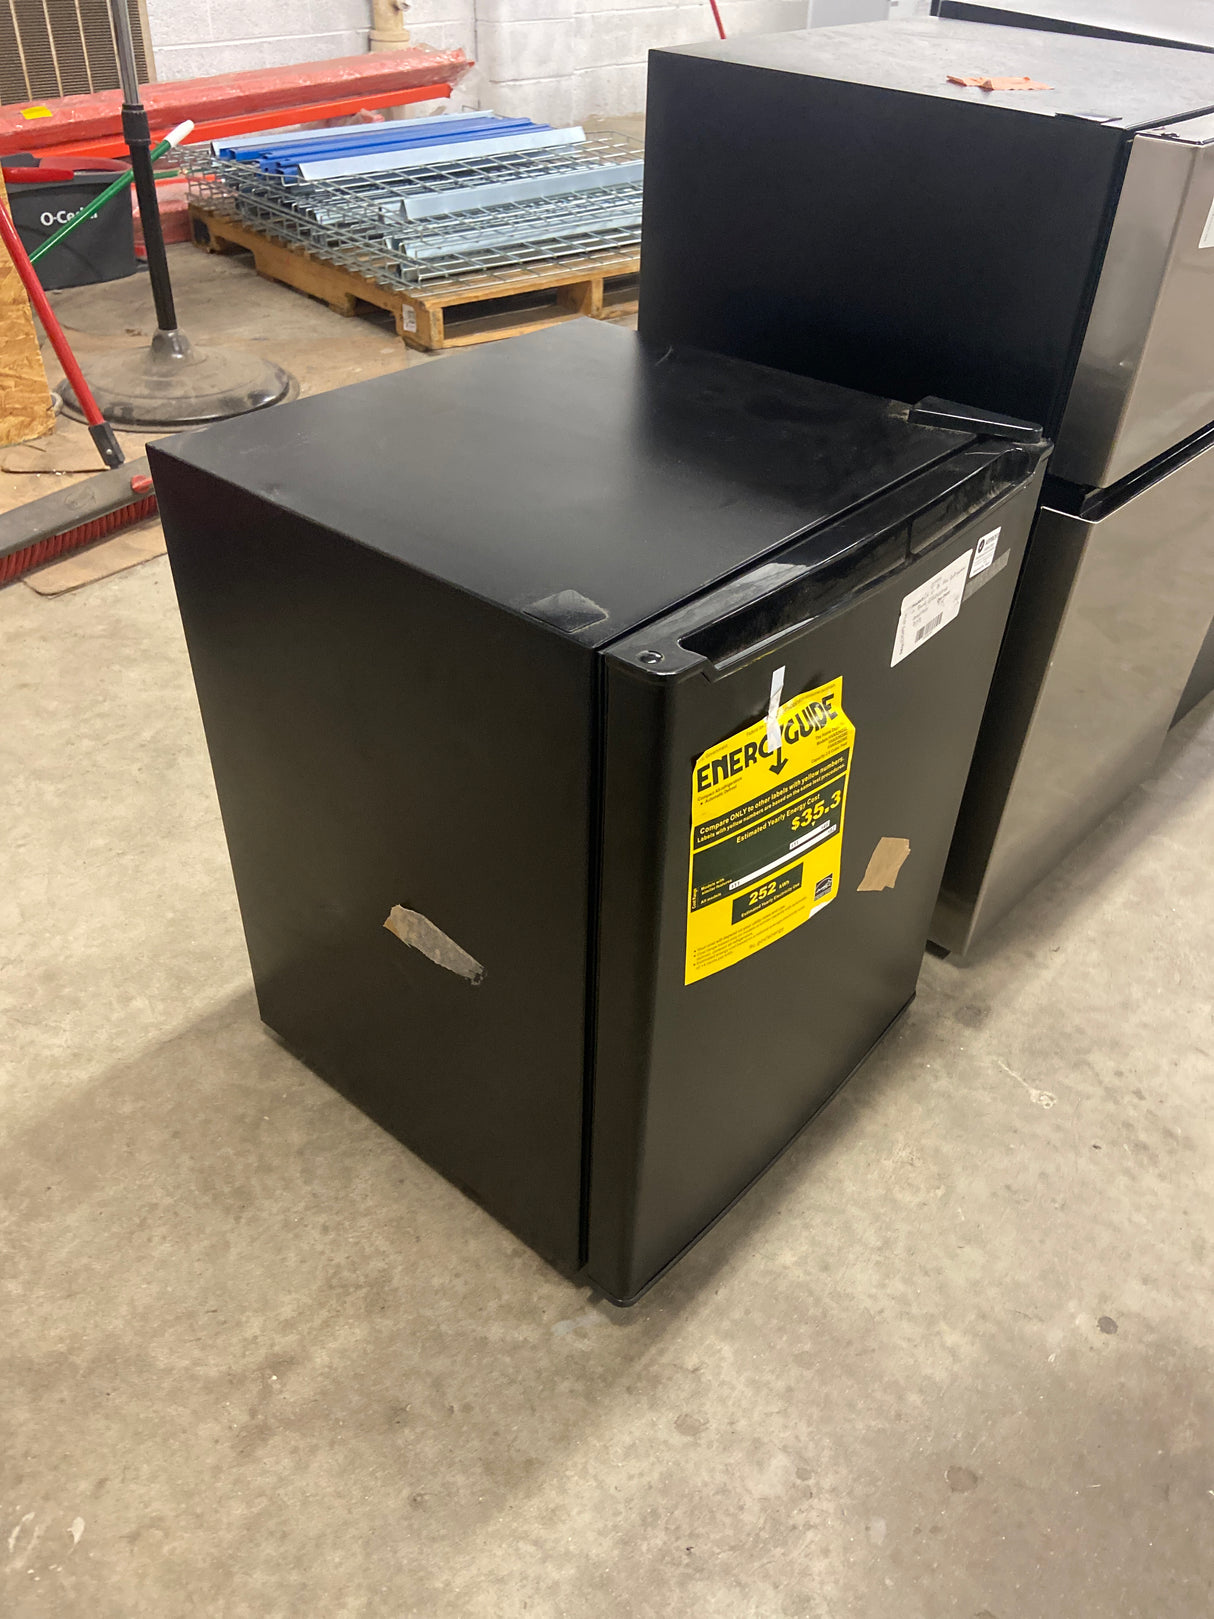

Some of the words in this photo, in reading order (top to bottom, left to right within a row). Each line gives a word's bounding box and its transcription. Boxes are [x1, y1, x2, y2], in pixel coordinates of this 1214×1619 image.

[40, 207, 98, 226] O-Ce
[698, 832, 715, 843] Labels
[716, 826, 726, 836] with
[726, 820, 742, 832] yellow
[743, 808, 764, 822] numbers
[772, 796, 786, 806] based
[700, 818, 729, 834] Compare
[730, 808, 747, 821] ONLY
[754, 796, 770, 808] other
[771, 787, 788, 800] labels
[789, 780, 800, 790] with
[802, 770, 820, 785] yellow
[736, 822, 767, 844] Estimated
[768, 814, 786, 826] Yearly
[786, 802, 806, 816] Energy
[806, 794, 820, 805] Cost
[791, 790, 841, 831] $35.3
[748, 881, 777, 906] 252
